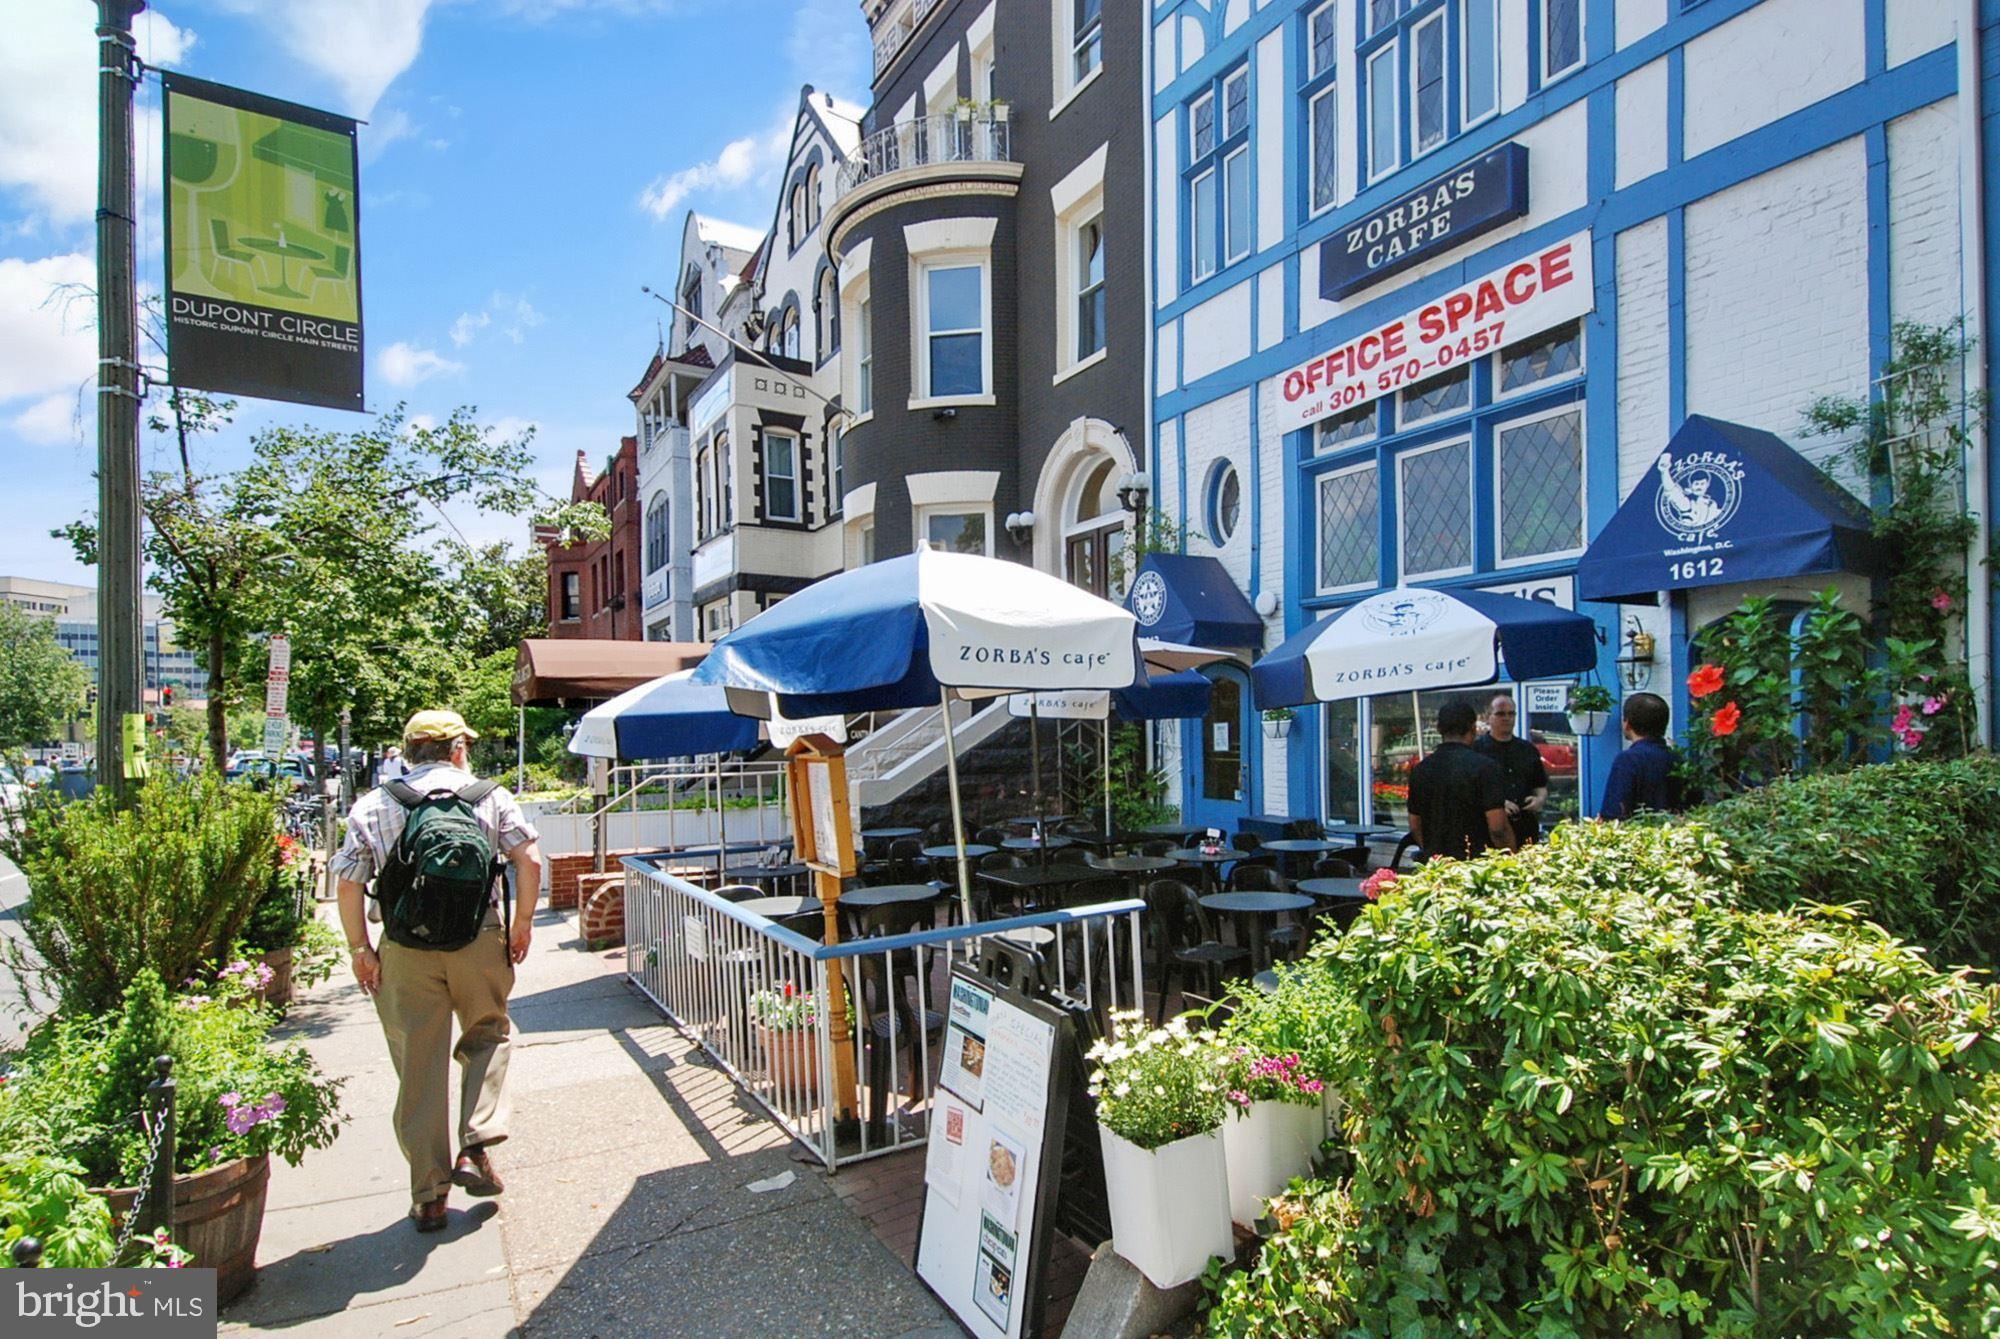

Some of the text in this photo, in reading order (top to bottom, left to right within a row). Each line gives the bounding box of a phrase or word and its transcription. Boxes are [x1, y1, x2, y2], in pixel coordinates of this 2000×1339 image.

[1347, 169, 1475, 254] ZORBA'S
[1366, 211, 1451, 269] CAFE
[172, 298, 359, 343] DUPONT CIRCLE
[173, 316, 359, 353] HISTORIC DUPONT CIRCLE MAIN STREETS
[1283, 244, 1574, 402] OFFICE SPACE
[1302, 321, 1505, 419] call 301 570-0457
[1674, 451, 1746, 481] ZORBA'S
[1669, 557, 1724, 581] 1612
[960, 646, 1050, 665] ZORBA'S
[1336, 663, 1414, 683] ZORBA'S
[1023, 699, 1067, 708] ZRBA'S
